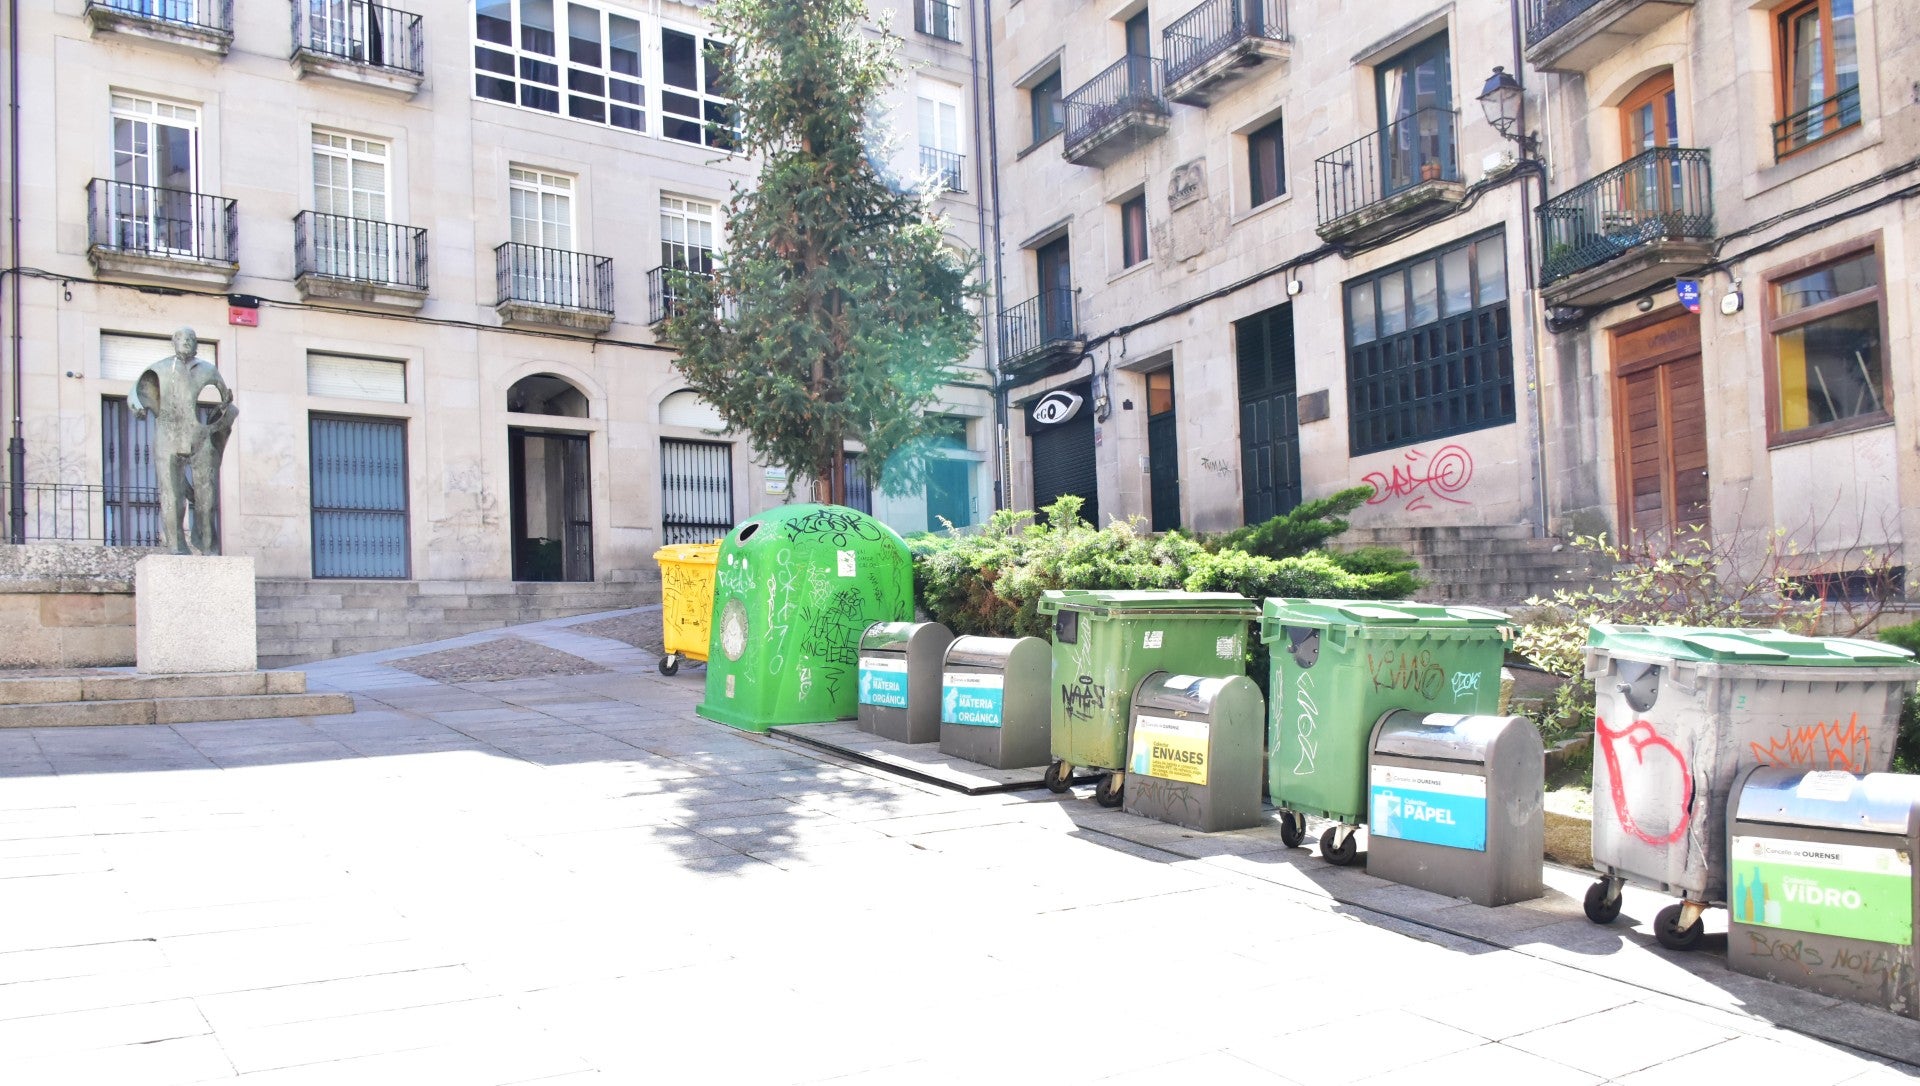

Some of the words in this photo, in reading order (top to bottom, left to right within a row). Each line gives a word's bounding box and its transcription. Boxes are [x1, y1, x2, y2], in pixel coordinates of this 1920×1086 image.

[873, 679, 900, 692] MATERIA
[872, 693, 906, 705] ORGÁNICA
[959, 698, 993, 710] MATERIA
[958, 711, 999, 724] ORGÁNICA
[1152, 746, 1204, 766] ENVASES
[1403, 804, 1456, 825] PAPEL
[1765, 847, 1792, 857] Concello
[1801, 851, 1840, 861] OURENSE
[1782, 883, 1862, 909] VIDRO
